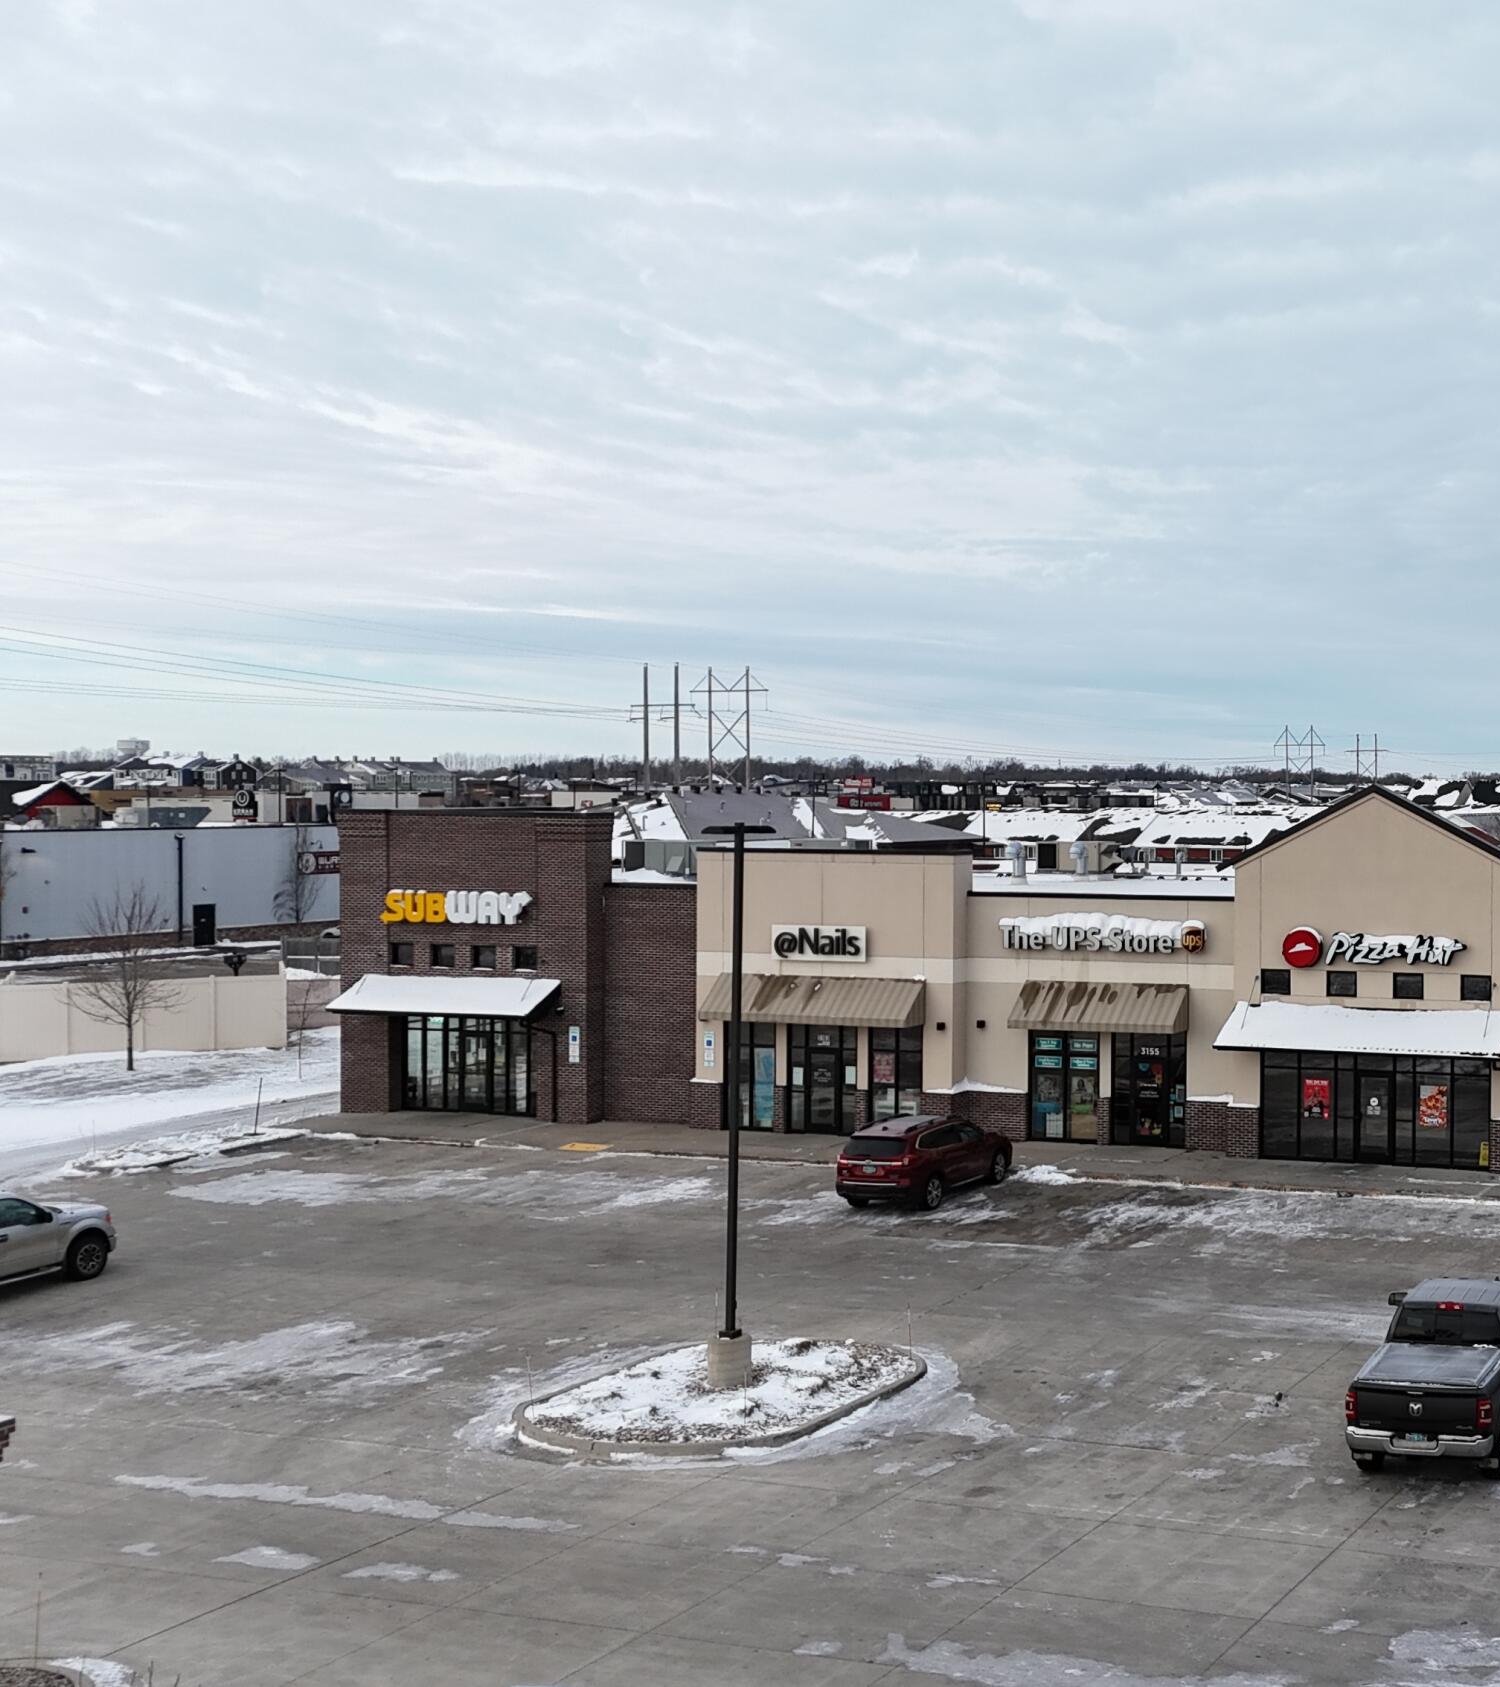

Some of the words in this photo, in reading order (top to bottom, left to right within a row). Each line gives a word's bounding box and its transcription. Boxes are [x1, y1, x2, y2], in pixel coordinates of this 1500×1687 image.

[379, 889, 533, 925] SUBWAY
[774, 927, 861, 959] @Nails
[1000, 925, 1045, 950] The
[1050, 926, 1100, 952] UPS
[1106, 927, 1174, 954] Store
[1182, 933, 1201, 950] ups
[1325, 932, 1402, 965] Pizza
[1404, 934, 1468, 966] Hut
[1140, 1047, 1160, 1056] 3155
